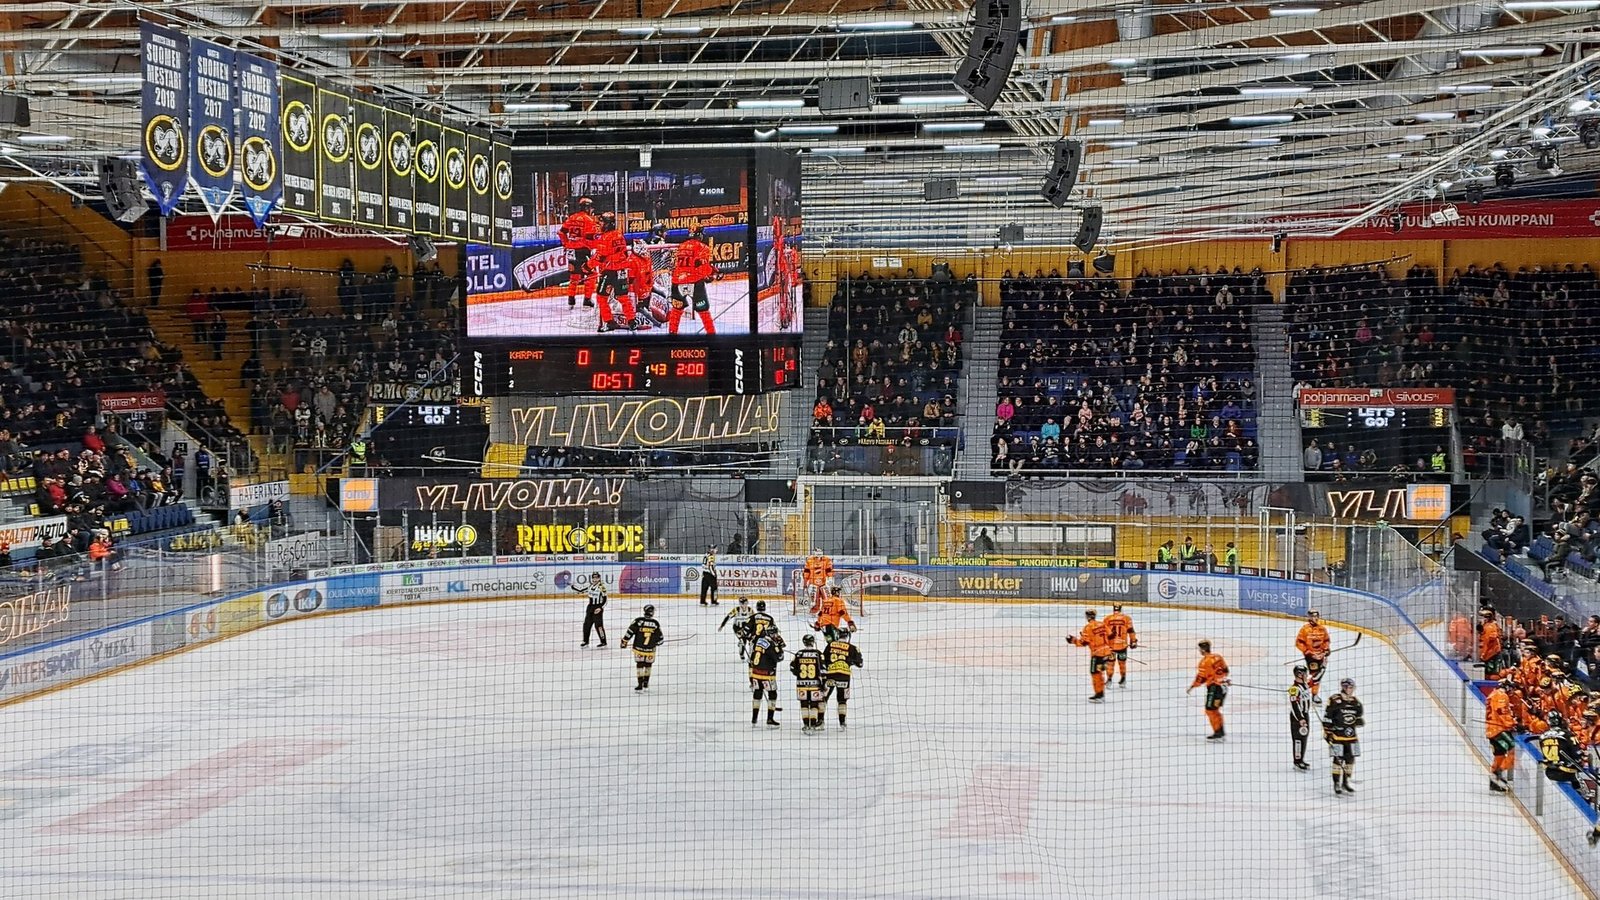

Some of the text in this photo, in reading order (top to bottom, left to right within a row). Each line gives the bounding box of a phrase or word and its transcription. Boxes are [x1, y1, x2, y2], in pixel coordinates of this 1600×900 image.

[147, 42, 180, 69] SUOMEN
[197, 55, 229, 81] SUOMEN
[147, 63, 181, 90] MESTARI
[242, 71, 271, 95] SUOMEN
[197, 76, 229, 100] MESTARI
[155, 87, 175, 109] 2018
[241, 90, 271, 114] MESTARI
[204, 98, 222, 118] 2017
[249, 111, 266, 132] 2012
[1479, 214, 1554, 227] KUMPPANI
[200, 226, 269, 239] punamust
[709, 237, 743, 261] ker
[466, 254, 500, 271] TEL
[509, 351, 544, 360] KARPAT
[578, 350, 589, 365] 0
[629, 350, 640, 364] 2
[473, 351, 483, 396] CCM
[508, 366, 513, 375] 1
[651, 363, 667, 376] 43
[676, 363, 704, 376] 2:00
[735, 349, 744, 394] CCM
[508, 380, 515, 388] 2
[592, 373, 633, 389] 10:57
[1303, 391, 1370, 404] pohjanmaan
[418, 406, 451, 415] LET'S
[1358, 407, 1395, 417] LET'S
[424, 415, 445, 425] GO!
[511, 391, 781, 447] YLIVOIMA!
[1365, 417, 1389, 427] GO!
[238, 482, 283, 501] HAVERINEN
[416, 479, 625, 511] YLIVOIMA!
[585, 525, 644, 552] SIDE
[736, 555, 776, 563] Efficient
[447, 576, 537, 593] KL mechanics
[576, 574, 614, 585] OU
[637, 575, 669, 584] oulu.com
[850, 572, 923, 588] pata ässä
[958, 573, 1023, 591] worker
[1051, 576, 1078, 592] IHKU
[1102, 577, 1130, 594] IHKU
[357, 586, 379, 596] KORU
[1180, 585, 1225, 598] SAKELA
[1246, 588, 1303, 608] Visma Sign
[298, 596, 317, 610] IKH
[10, 649, 81, 687] INTERSPORT
